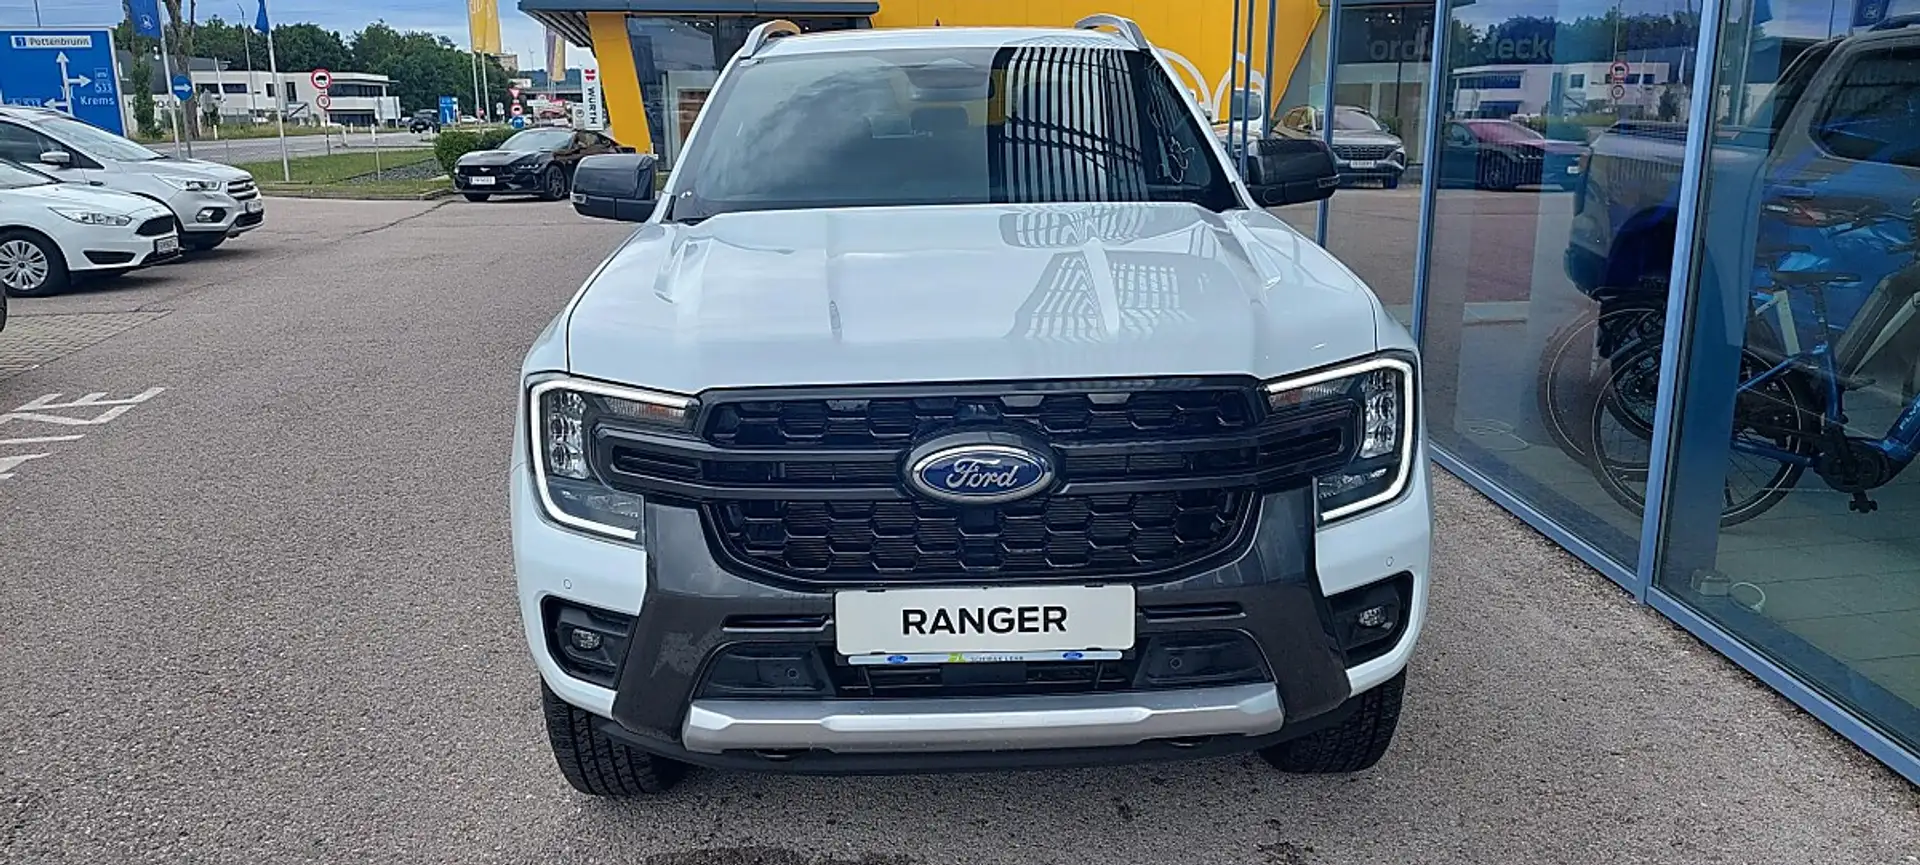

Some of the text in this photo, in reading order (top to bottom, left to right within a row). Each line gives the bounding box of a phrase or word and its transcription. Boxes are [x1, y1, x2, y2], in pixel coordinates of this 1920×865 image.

[29, 37, 89, 46] Pottenbrunn
[80, 95, 114, 105] Krems
[946, 458, 1018, 488] Ford
[902, 606, 1067, 634] RANGER
